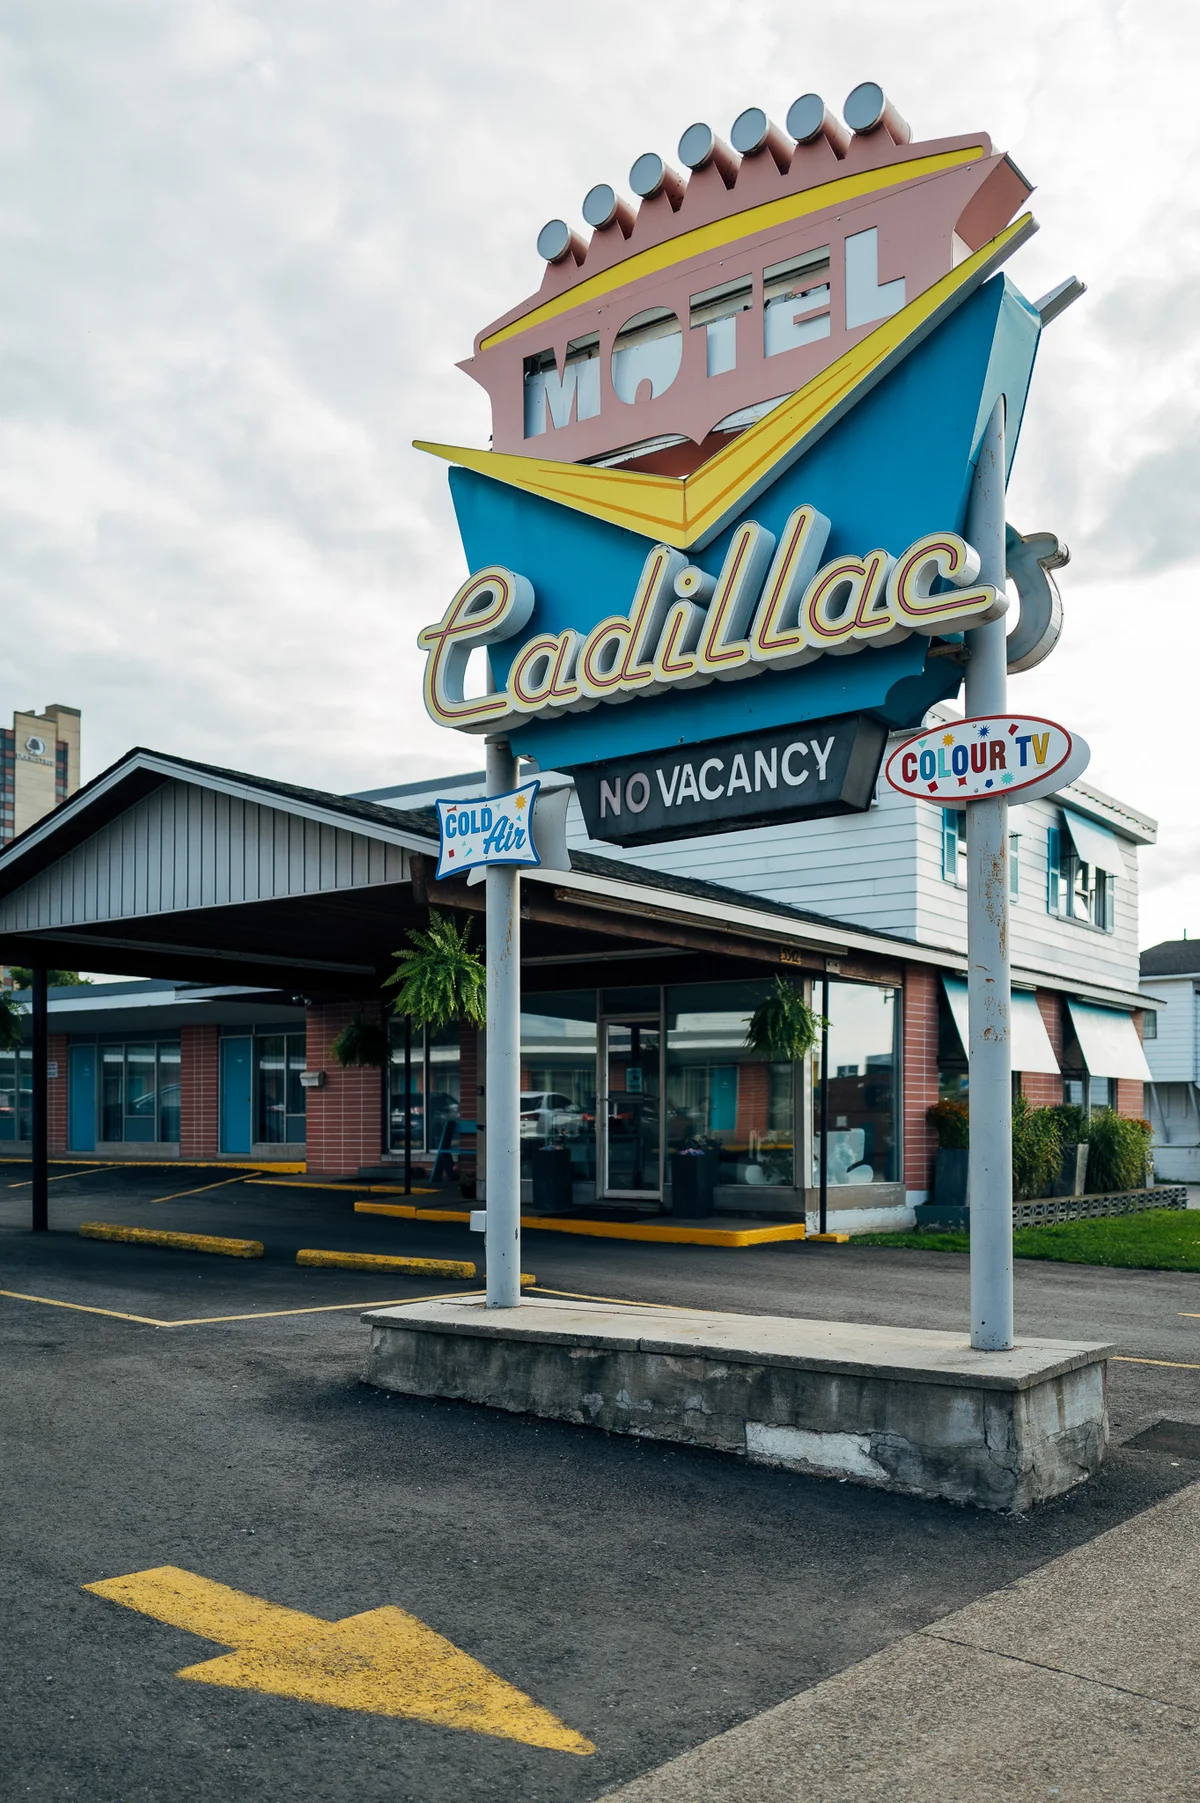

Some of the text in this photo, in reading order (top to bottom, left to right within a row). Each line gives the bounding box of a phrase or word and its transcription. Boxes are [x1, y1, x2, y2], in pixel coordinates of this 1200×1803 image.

[523, 226, 905, 439] MOTEL
[417, 504, 1009, 731] Cadillac
[600, 736, 835, 819] NO VACANCY
[902, 732, 1050, 783] COLOUR TV
[445, 807, 492, 839] COLD
[483, 815, 526, 855] Air
